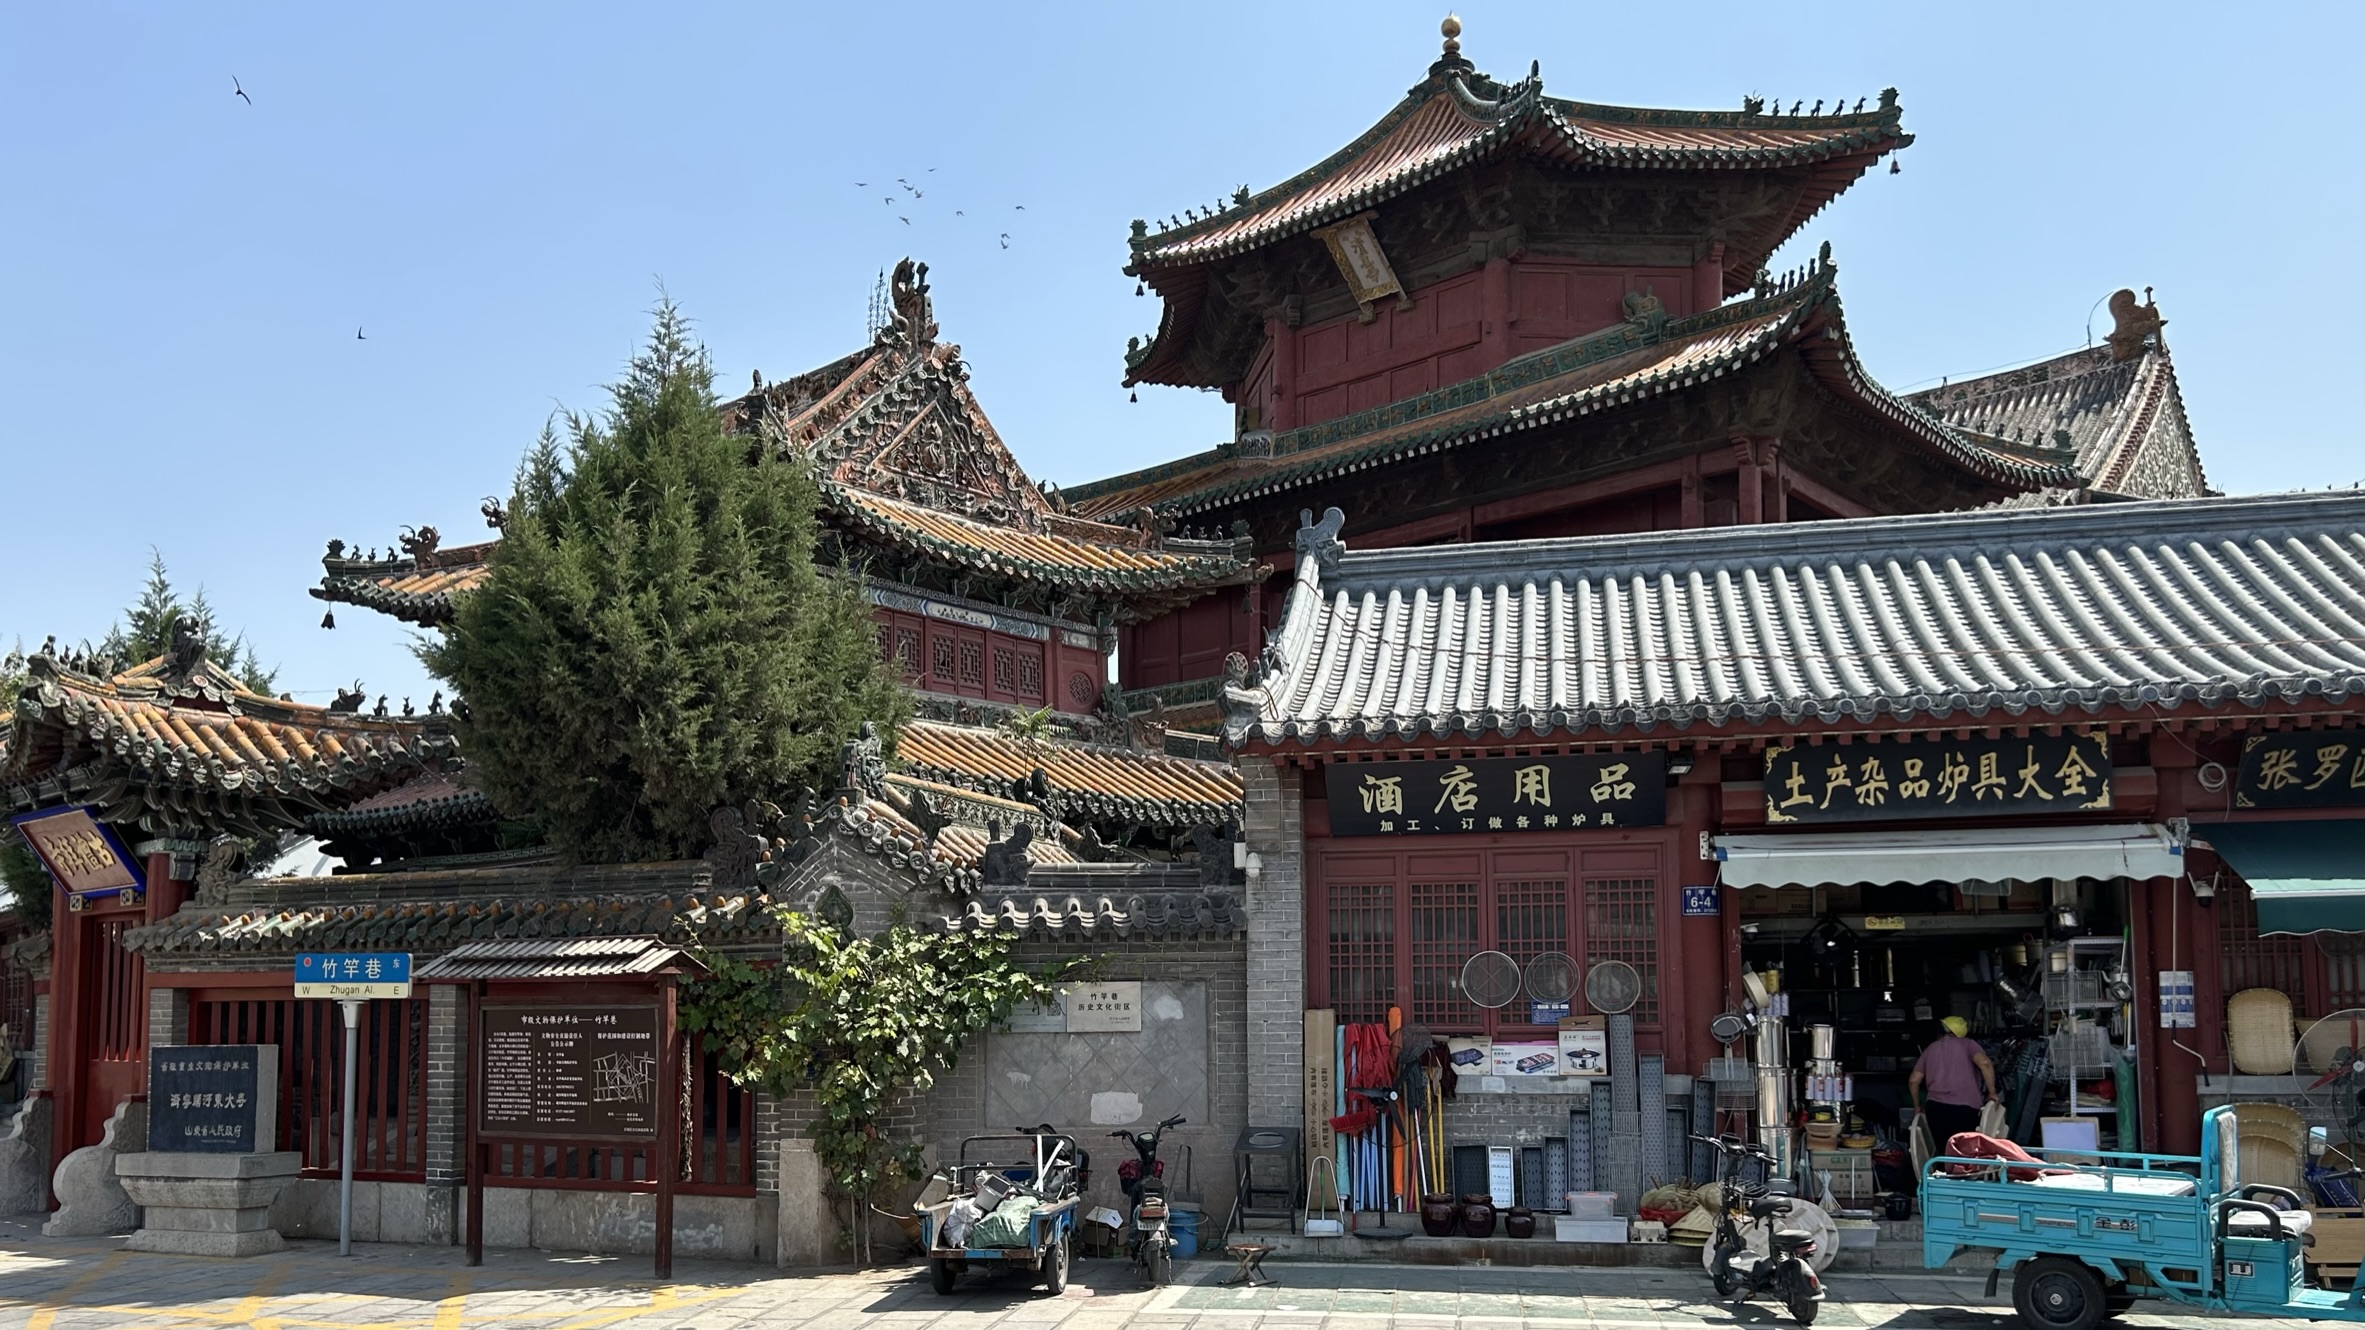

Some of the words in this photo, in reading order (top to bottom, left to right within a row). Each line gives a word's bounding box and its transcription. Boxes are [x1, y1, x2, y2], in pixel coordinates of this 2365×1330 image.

[1779, 744, 2097, 810] 土产杂品炉具大全
[1357, 762, 1637, 815] 酒店用品
[1380, 812, 1615, 832] 加工、订做各种炉具
[1690, 896, 1712, 908] 6-4
[322, 957, 382, 979] 竹竿巷
[392, 958, 401, 968] 东
[302, 986, 311, 995] W
[329, 985, 360, 996] Zhugan
[364, 985, 375, 994] Al.
[393, 986, 400, 995] E
[1090, 992, 1119, 1001] 竹竿巷
[1077, 1002, 1131, 1012] 历史文化街区
